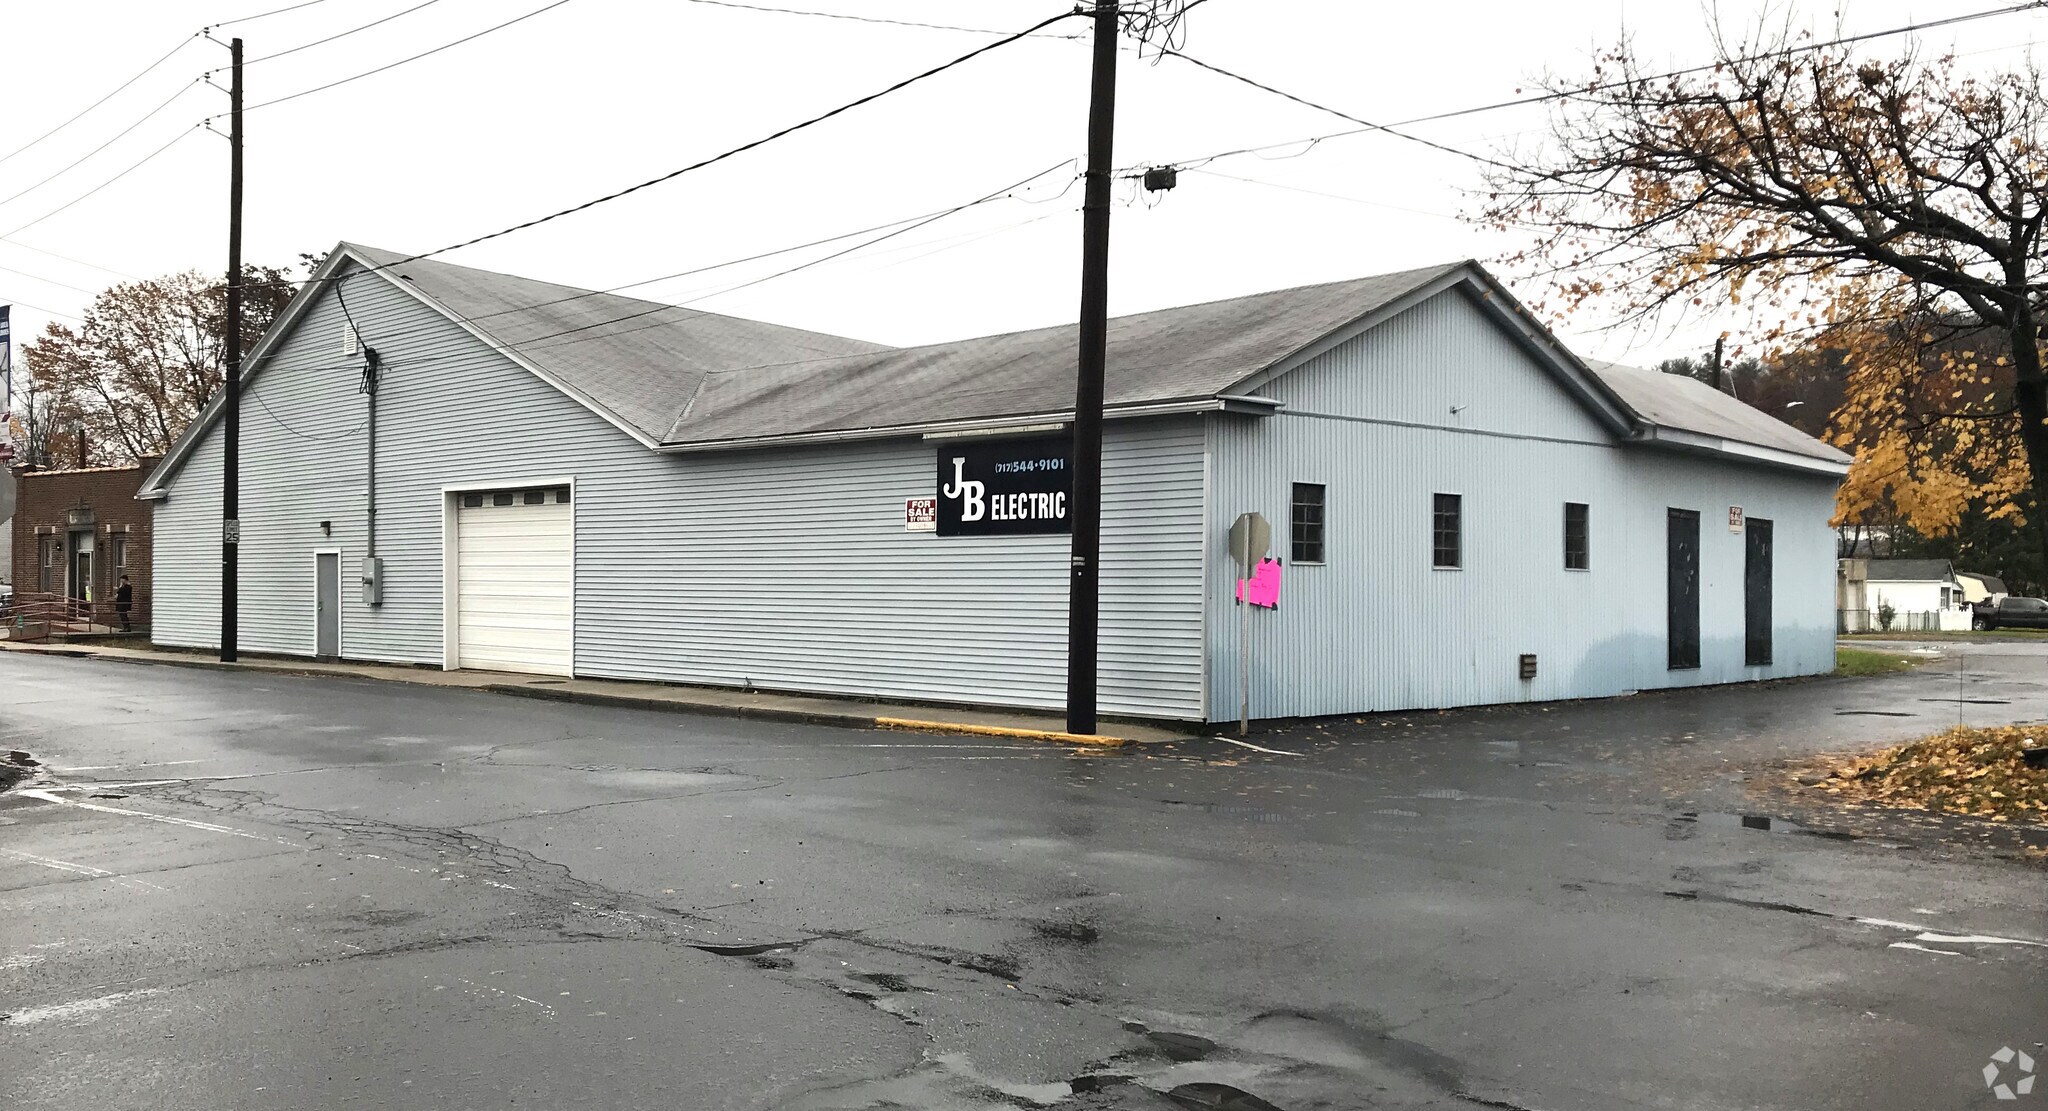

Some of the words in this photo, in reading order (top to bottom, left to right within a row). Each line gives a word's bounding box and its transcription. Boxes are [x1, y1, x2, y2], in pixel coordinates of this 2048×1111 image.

[911, 500, 931, 509] FOR
[991, 491, 1066, 521] ELECTRIC
[908, 507, 935, 517] SALE
[226, 532, 239, 542] 25
